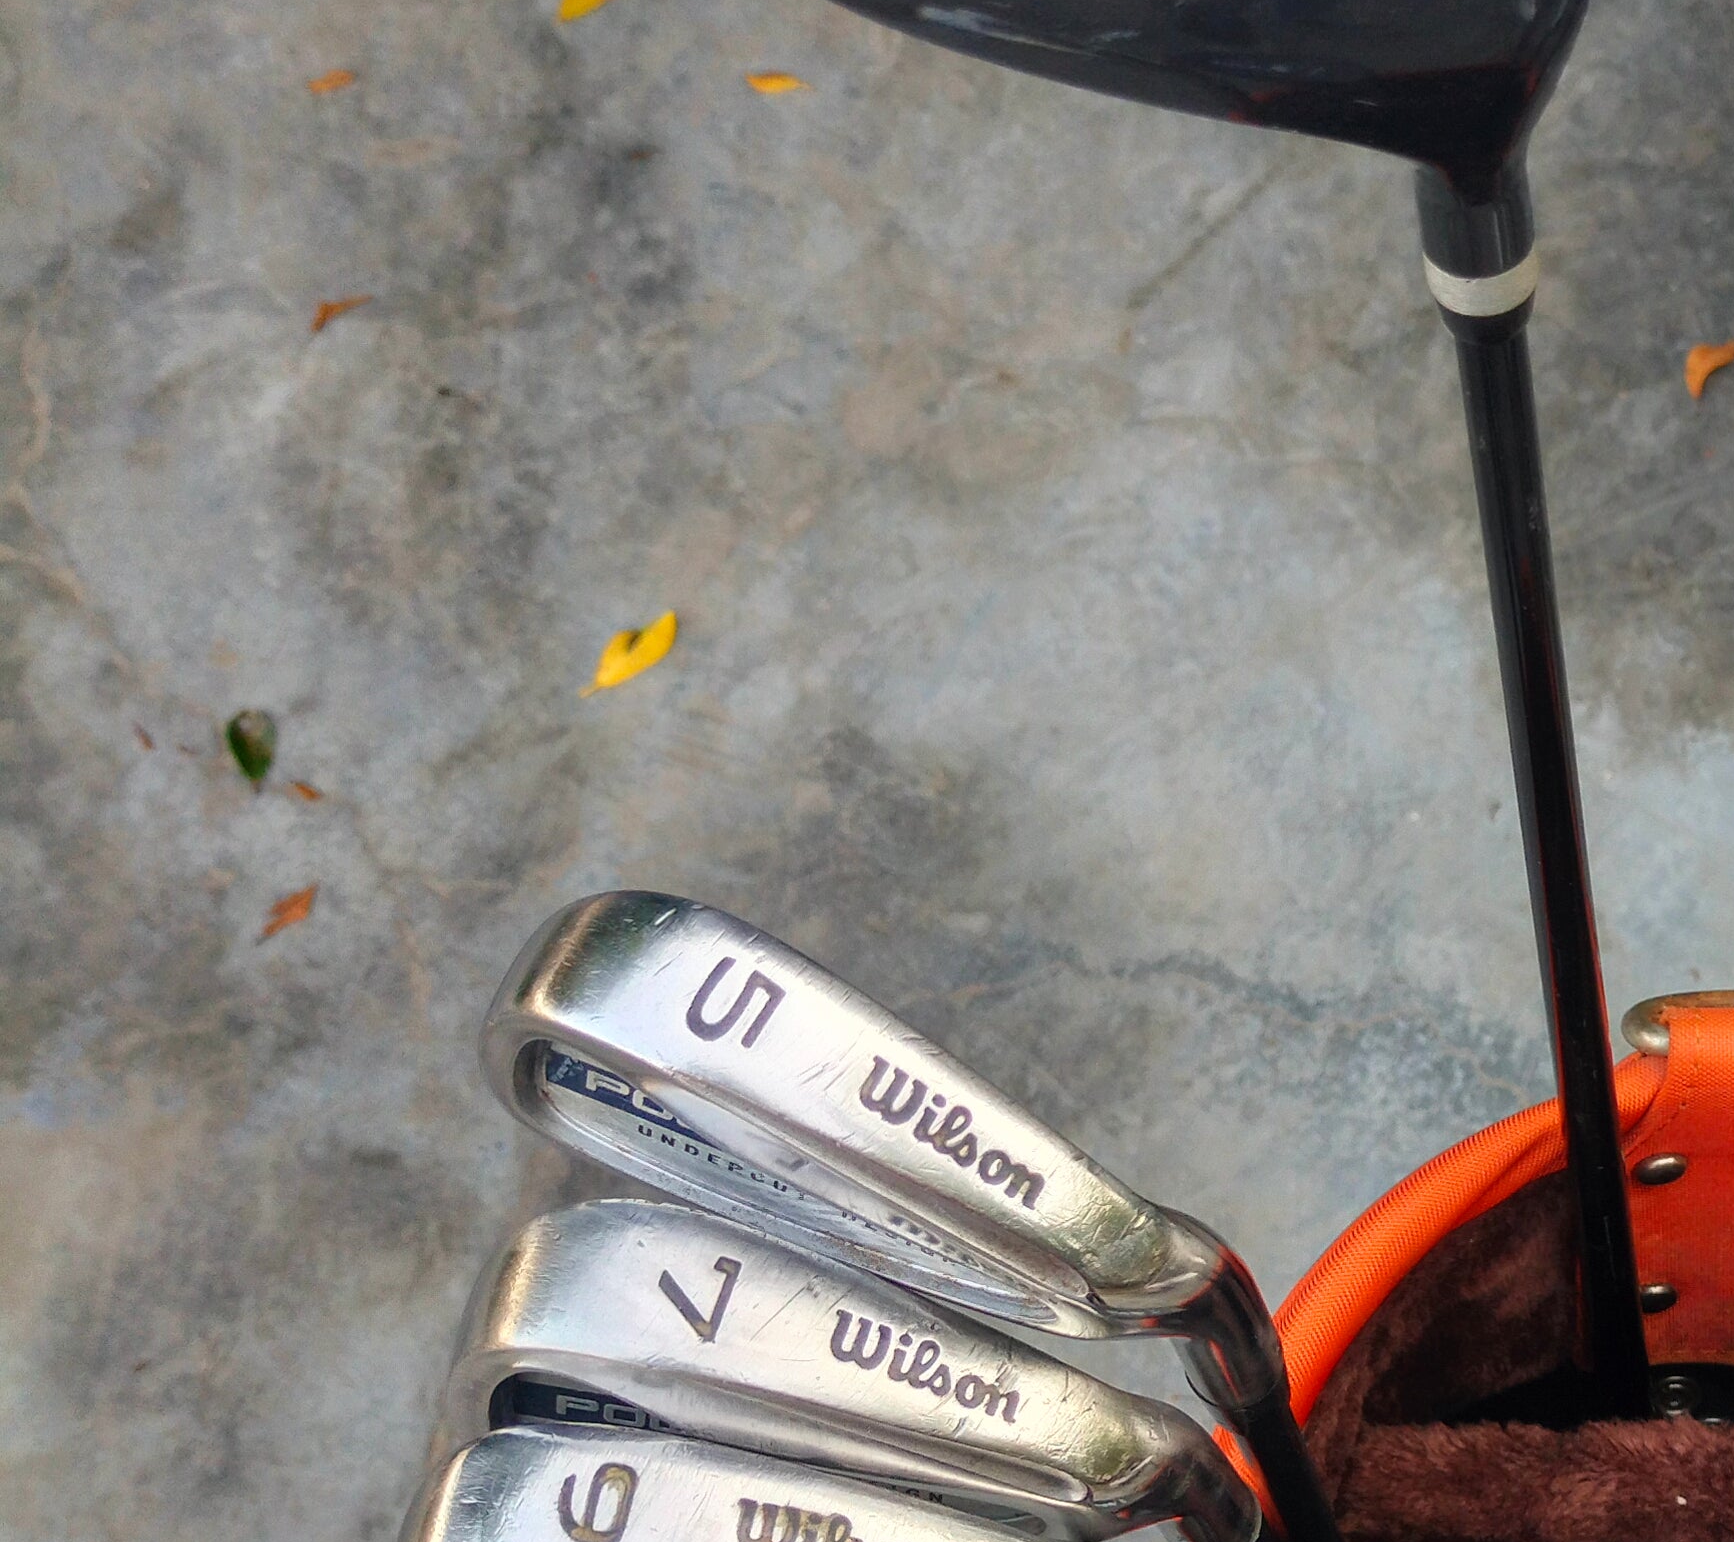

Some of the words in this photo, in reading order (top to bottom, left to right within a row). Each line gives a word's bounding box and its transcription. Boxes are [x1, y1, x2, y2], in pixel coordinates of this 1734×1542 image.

[684, 955, 786, 1049] 5
[858, 1053, 1046, 1211] Wilson
[659, 1255, 741, 1342] 7
[828, 1308, 1019, 1425] Wilson
